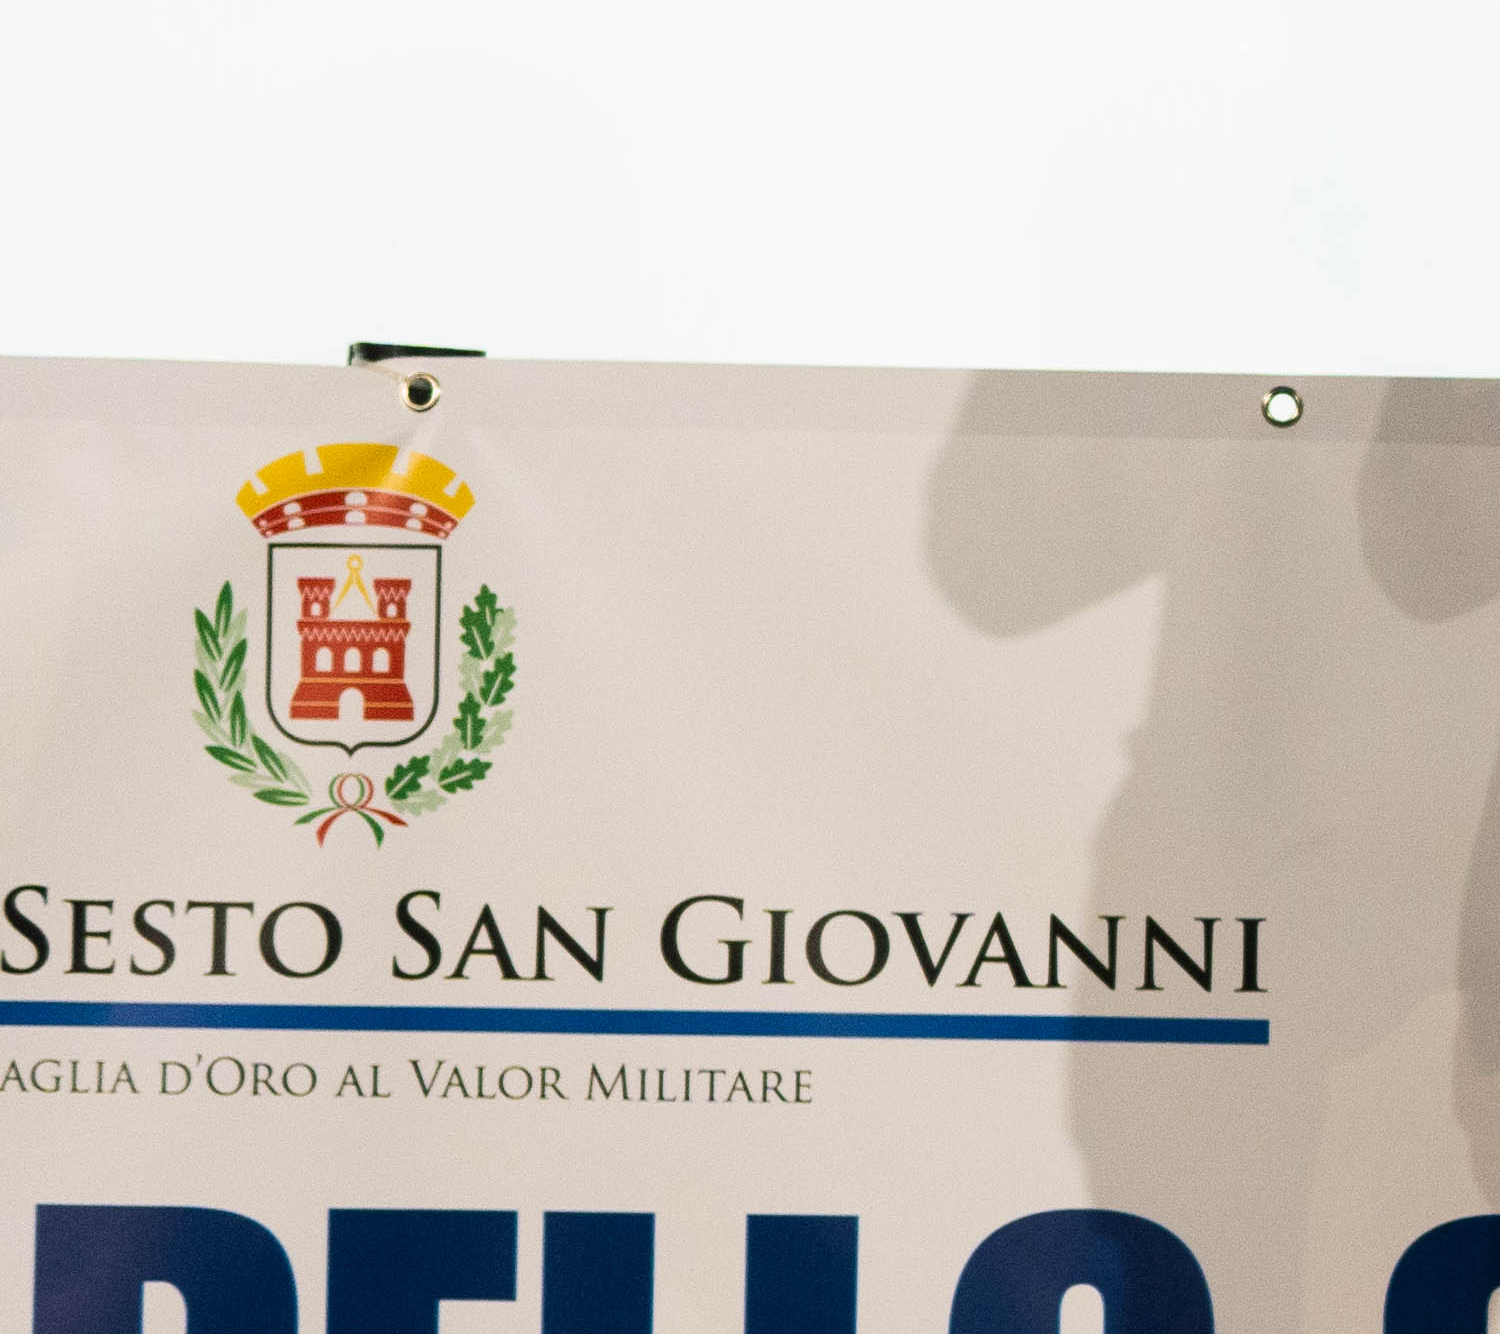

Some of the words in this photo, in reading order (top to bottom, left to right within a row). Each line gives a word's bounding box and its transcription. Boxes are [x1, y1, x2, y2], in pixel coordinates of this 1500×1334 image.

[159, 1053, 317, 1098] D'ORO
[334, 1063, 391, 1099] AL
[408, 1058, 568, 1101] VALOR
[585, 1062, 813, 1104] MILITARE
